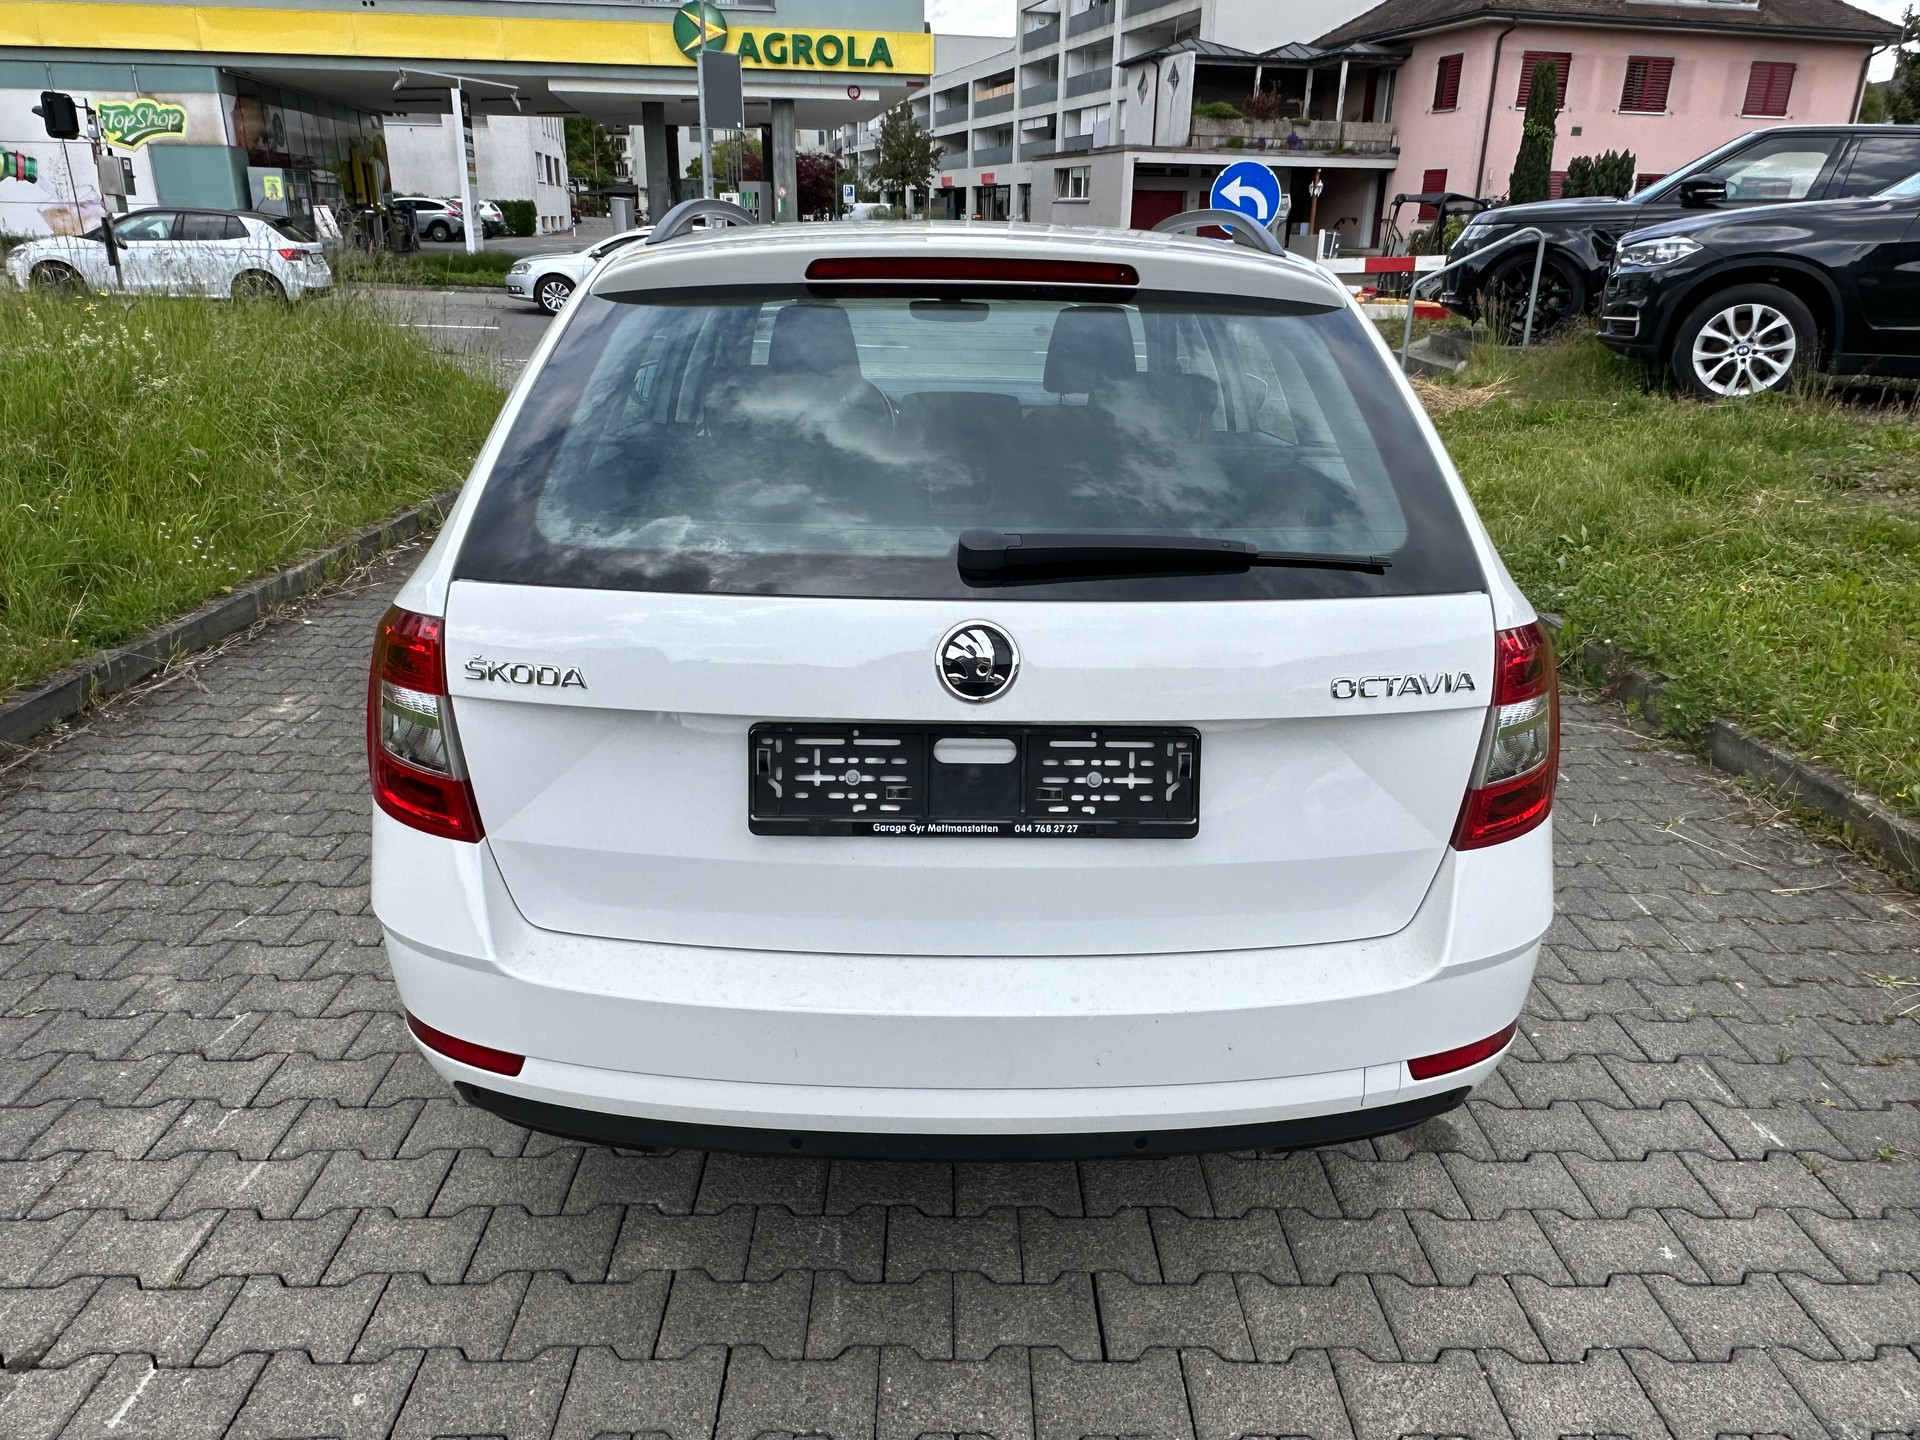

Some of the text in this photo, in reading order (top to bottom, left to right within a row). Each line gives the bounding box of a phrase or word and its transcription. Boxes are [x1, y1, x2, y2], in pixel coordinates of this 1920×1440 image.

[738, 32, 894, 68] AGROLA
[464, 654, 588, 690] ŠKODA
[1330, 671, 1476, 699] OCTAVIA
[872, 823, 907, 834] Garage
[909, 824, 926, 834] Gyr
[1014, 824, 1033, 833] 044
[1034, 824, 1052, 833] 768
[1053, 824, 1066, 833] 27
[1066, 824, 1079, 833] 27
